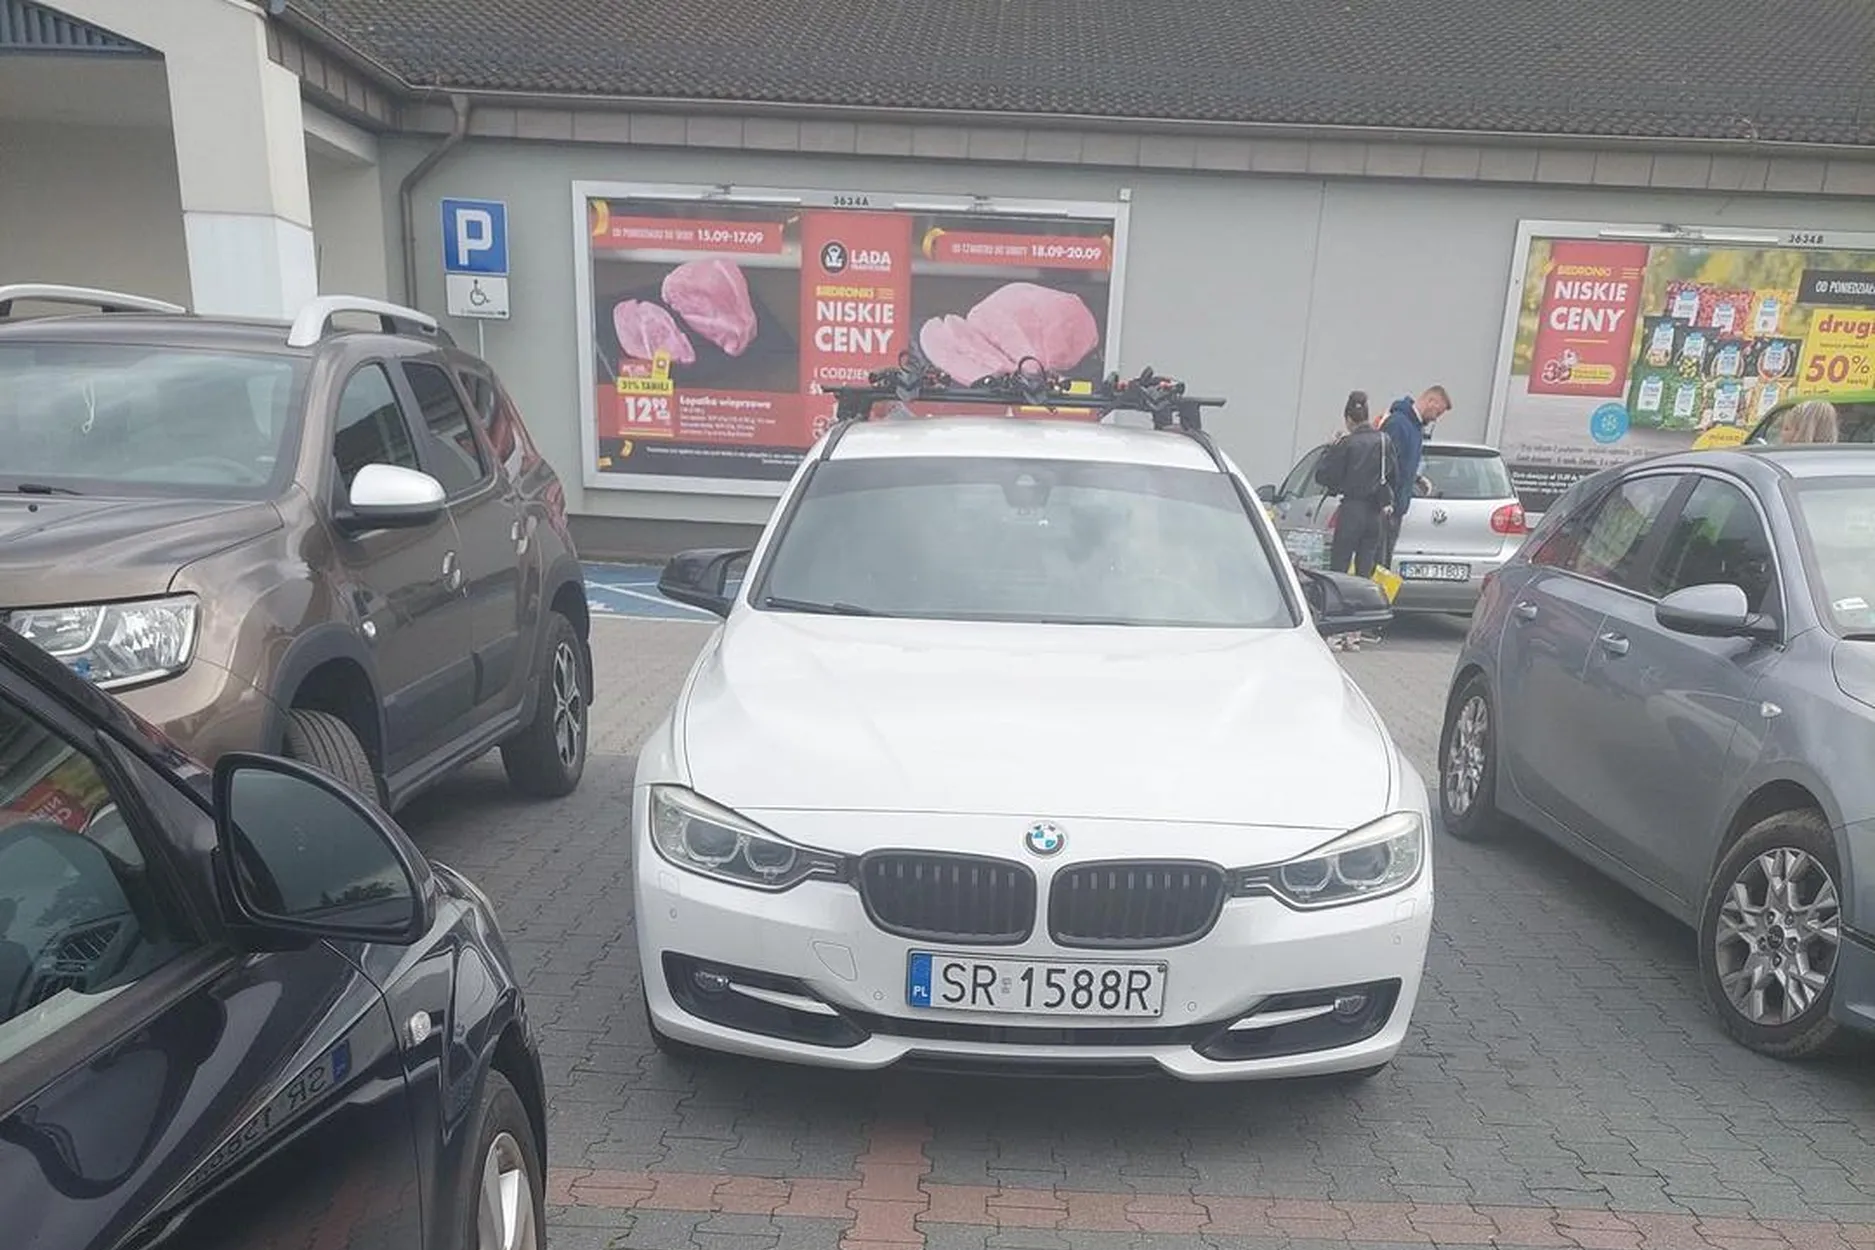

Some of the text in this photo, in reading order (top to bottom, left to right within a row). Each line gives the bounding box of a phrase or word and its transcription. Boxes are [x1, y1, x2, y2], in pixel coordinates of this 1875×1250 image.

[456, 208, 493, 265] P
[698, 229, 764, 245] 15.09-17.09
[851, 249, 892, 265] LADA
[1032, 244, 1102, 260] 18.09-20.09
[1554, 280, 1629, 302] NISKIE
[816, 300, 895, 324] NISKIE
[1549, 306, 1625, 332] CENY
[814, 326, 895, 354] CENY
[1805, 354, 1870, 383] 50%
[625, 396, 653, 422] 12
[914, 985, 928, 997] PL
[942, 963, 1151, 1011] SR 1588R
